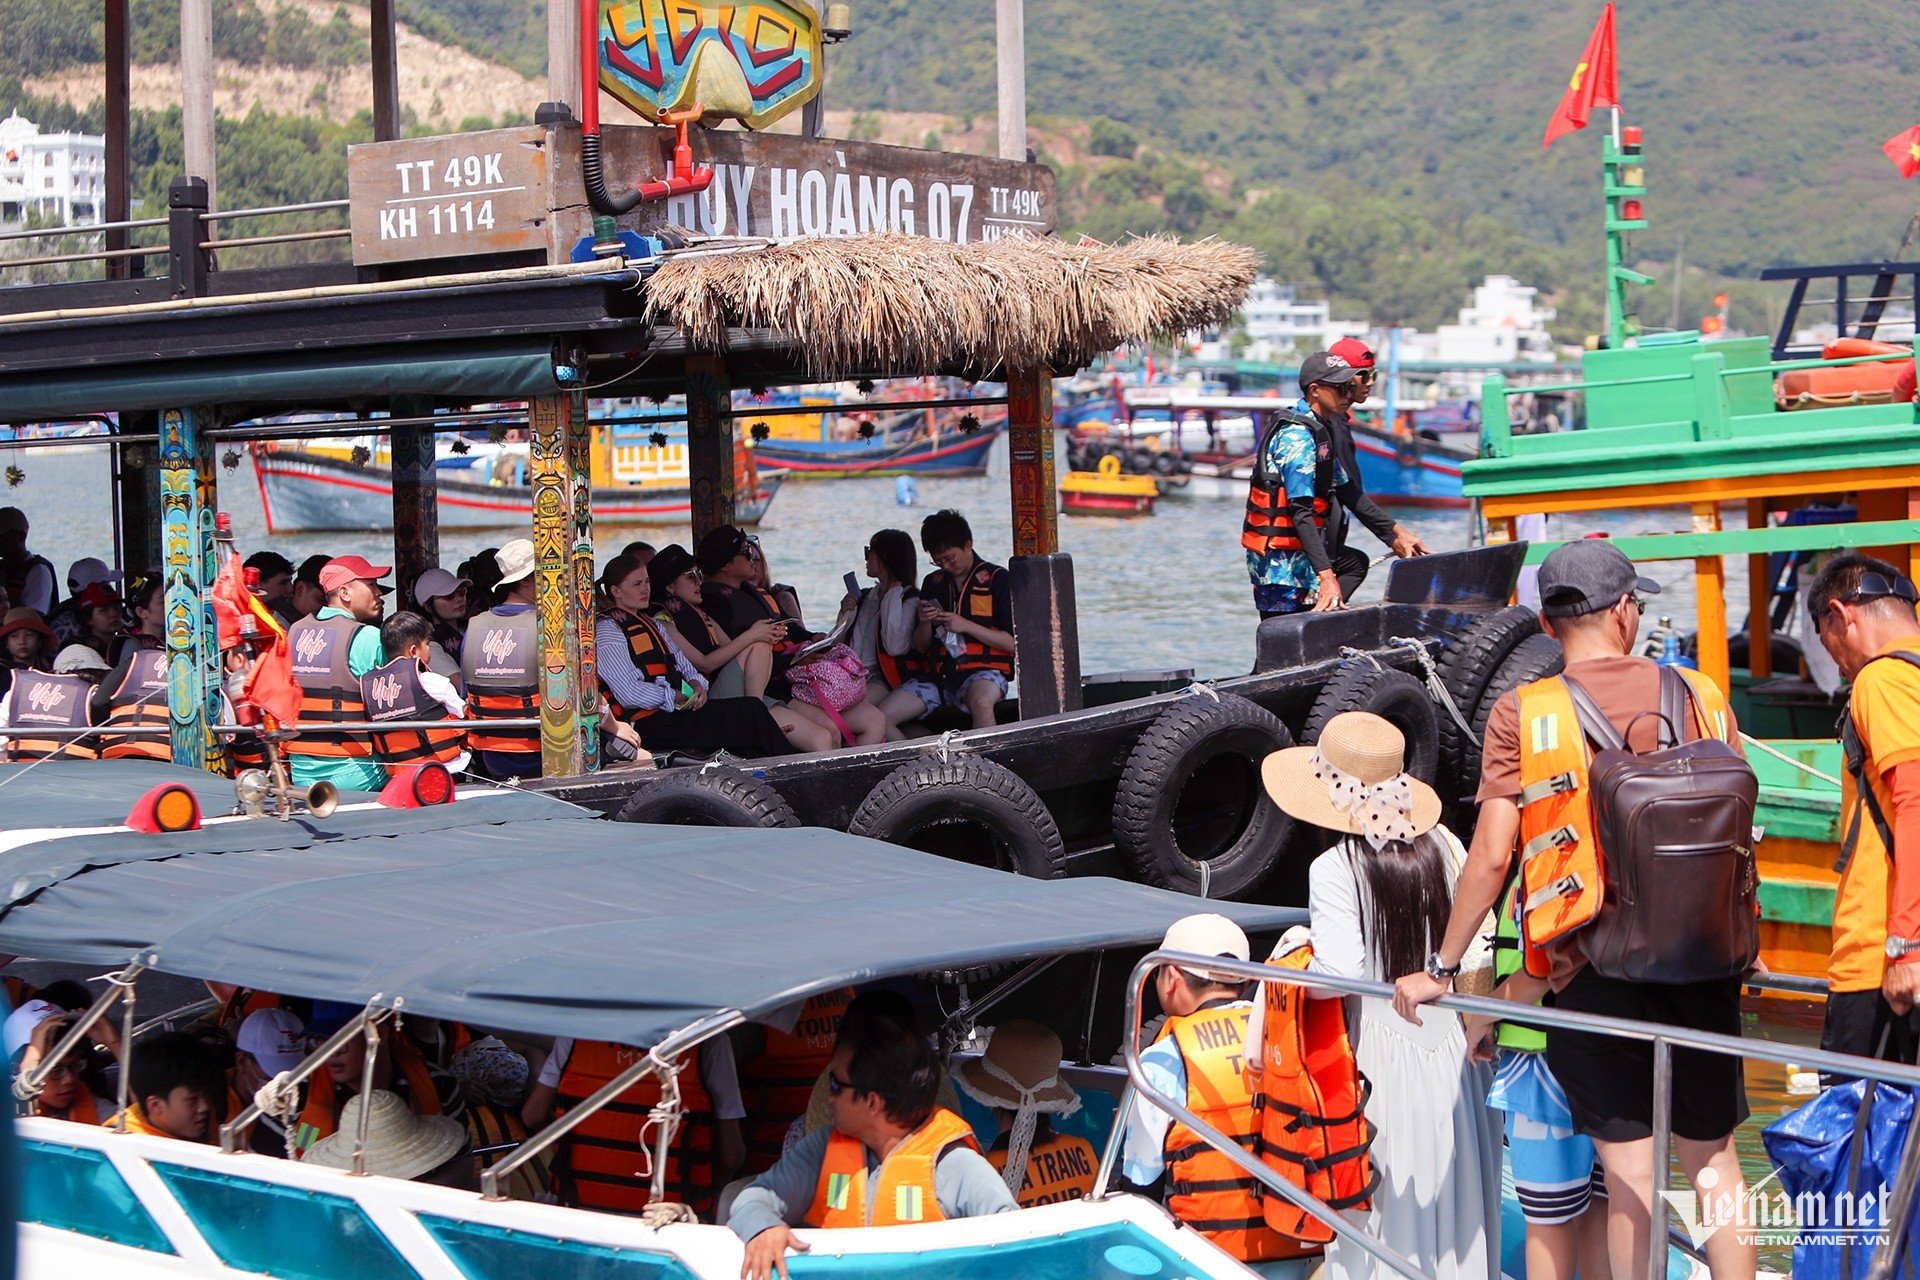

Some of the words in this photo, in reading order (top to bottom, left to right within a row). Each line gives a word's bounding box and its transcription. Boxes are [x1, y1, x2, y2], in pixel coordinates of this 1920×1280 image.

[396, 160, 434, 194] TT
[444, 153, 504, 188] 49K
[667, 160, 755, 237] HUY
[770, 151, 915, 238] HOÀNG
[928, 182, 974, 245] 07
[990, 186, 1009, 213] TT
[1012, 189, 1041, 216] 49K
[380, 206, 417, 240] KH
[428, 199, 495, 235] 1114
[1193, 1017, 1242, 1052] NHA
[1031, 1146, 1092, 1186] TRANG
